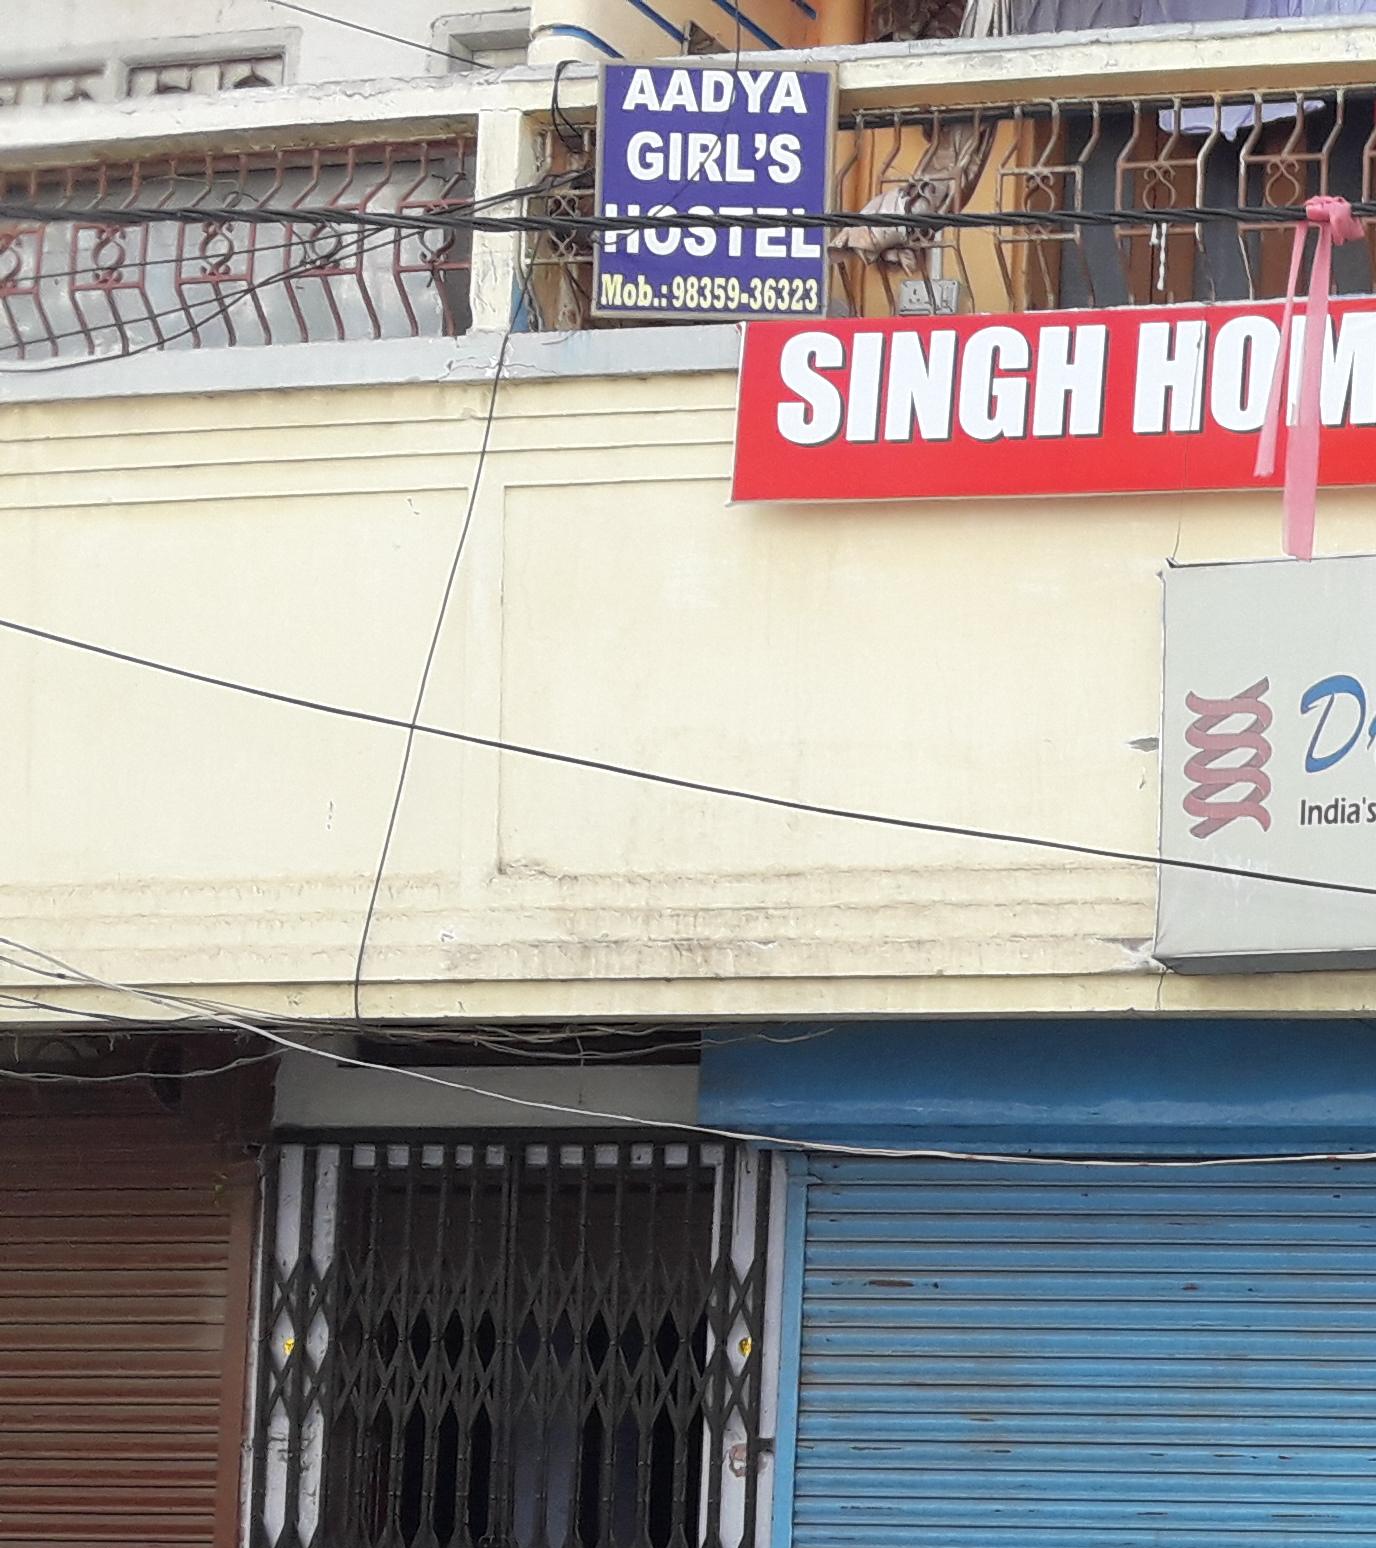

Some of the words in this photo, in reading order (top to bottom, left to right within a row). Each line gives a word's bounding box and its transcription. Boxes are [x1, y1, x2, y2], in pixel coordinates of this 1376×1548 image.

[622, 68, 808, 113] AADYA
[627, 131, 801, 183] GIRL'S
[604, 203, 821, 258] HOSTEL
[777, 324, 1107, 447] SINGH
